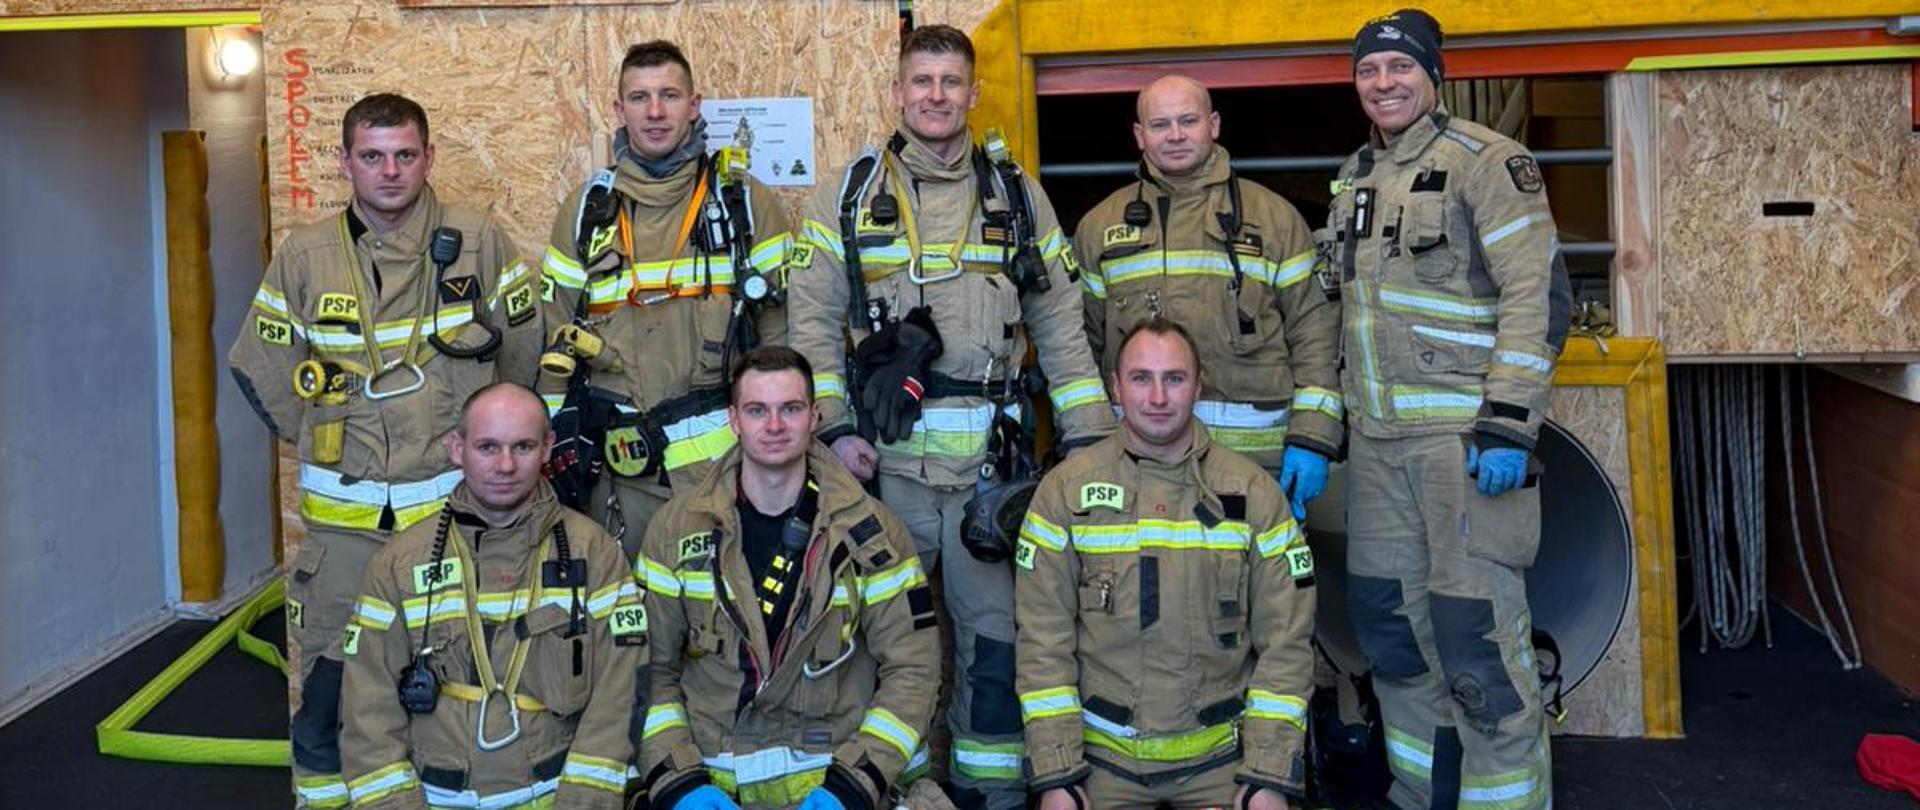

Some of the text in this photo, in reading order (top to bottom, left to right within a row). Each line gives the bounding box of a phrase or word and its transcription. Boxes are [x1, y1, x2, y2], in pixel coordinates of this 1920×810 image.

[1107, 224, 1136, 242] PSP
[322, 297, 357, 314] PSP
[259, 320, 286, 341] PSP
[1087, 486, 1119, 502] PSP
[421, 563, 454, 587] PP
[615, 609, 643, 628] PSP
